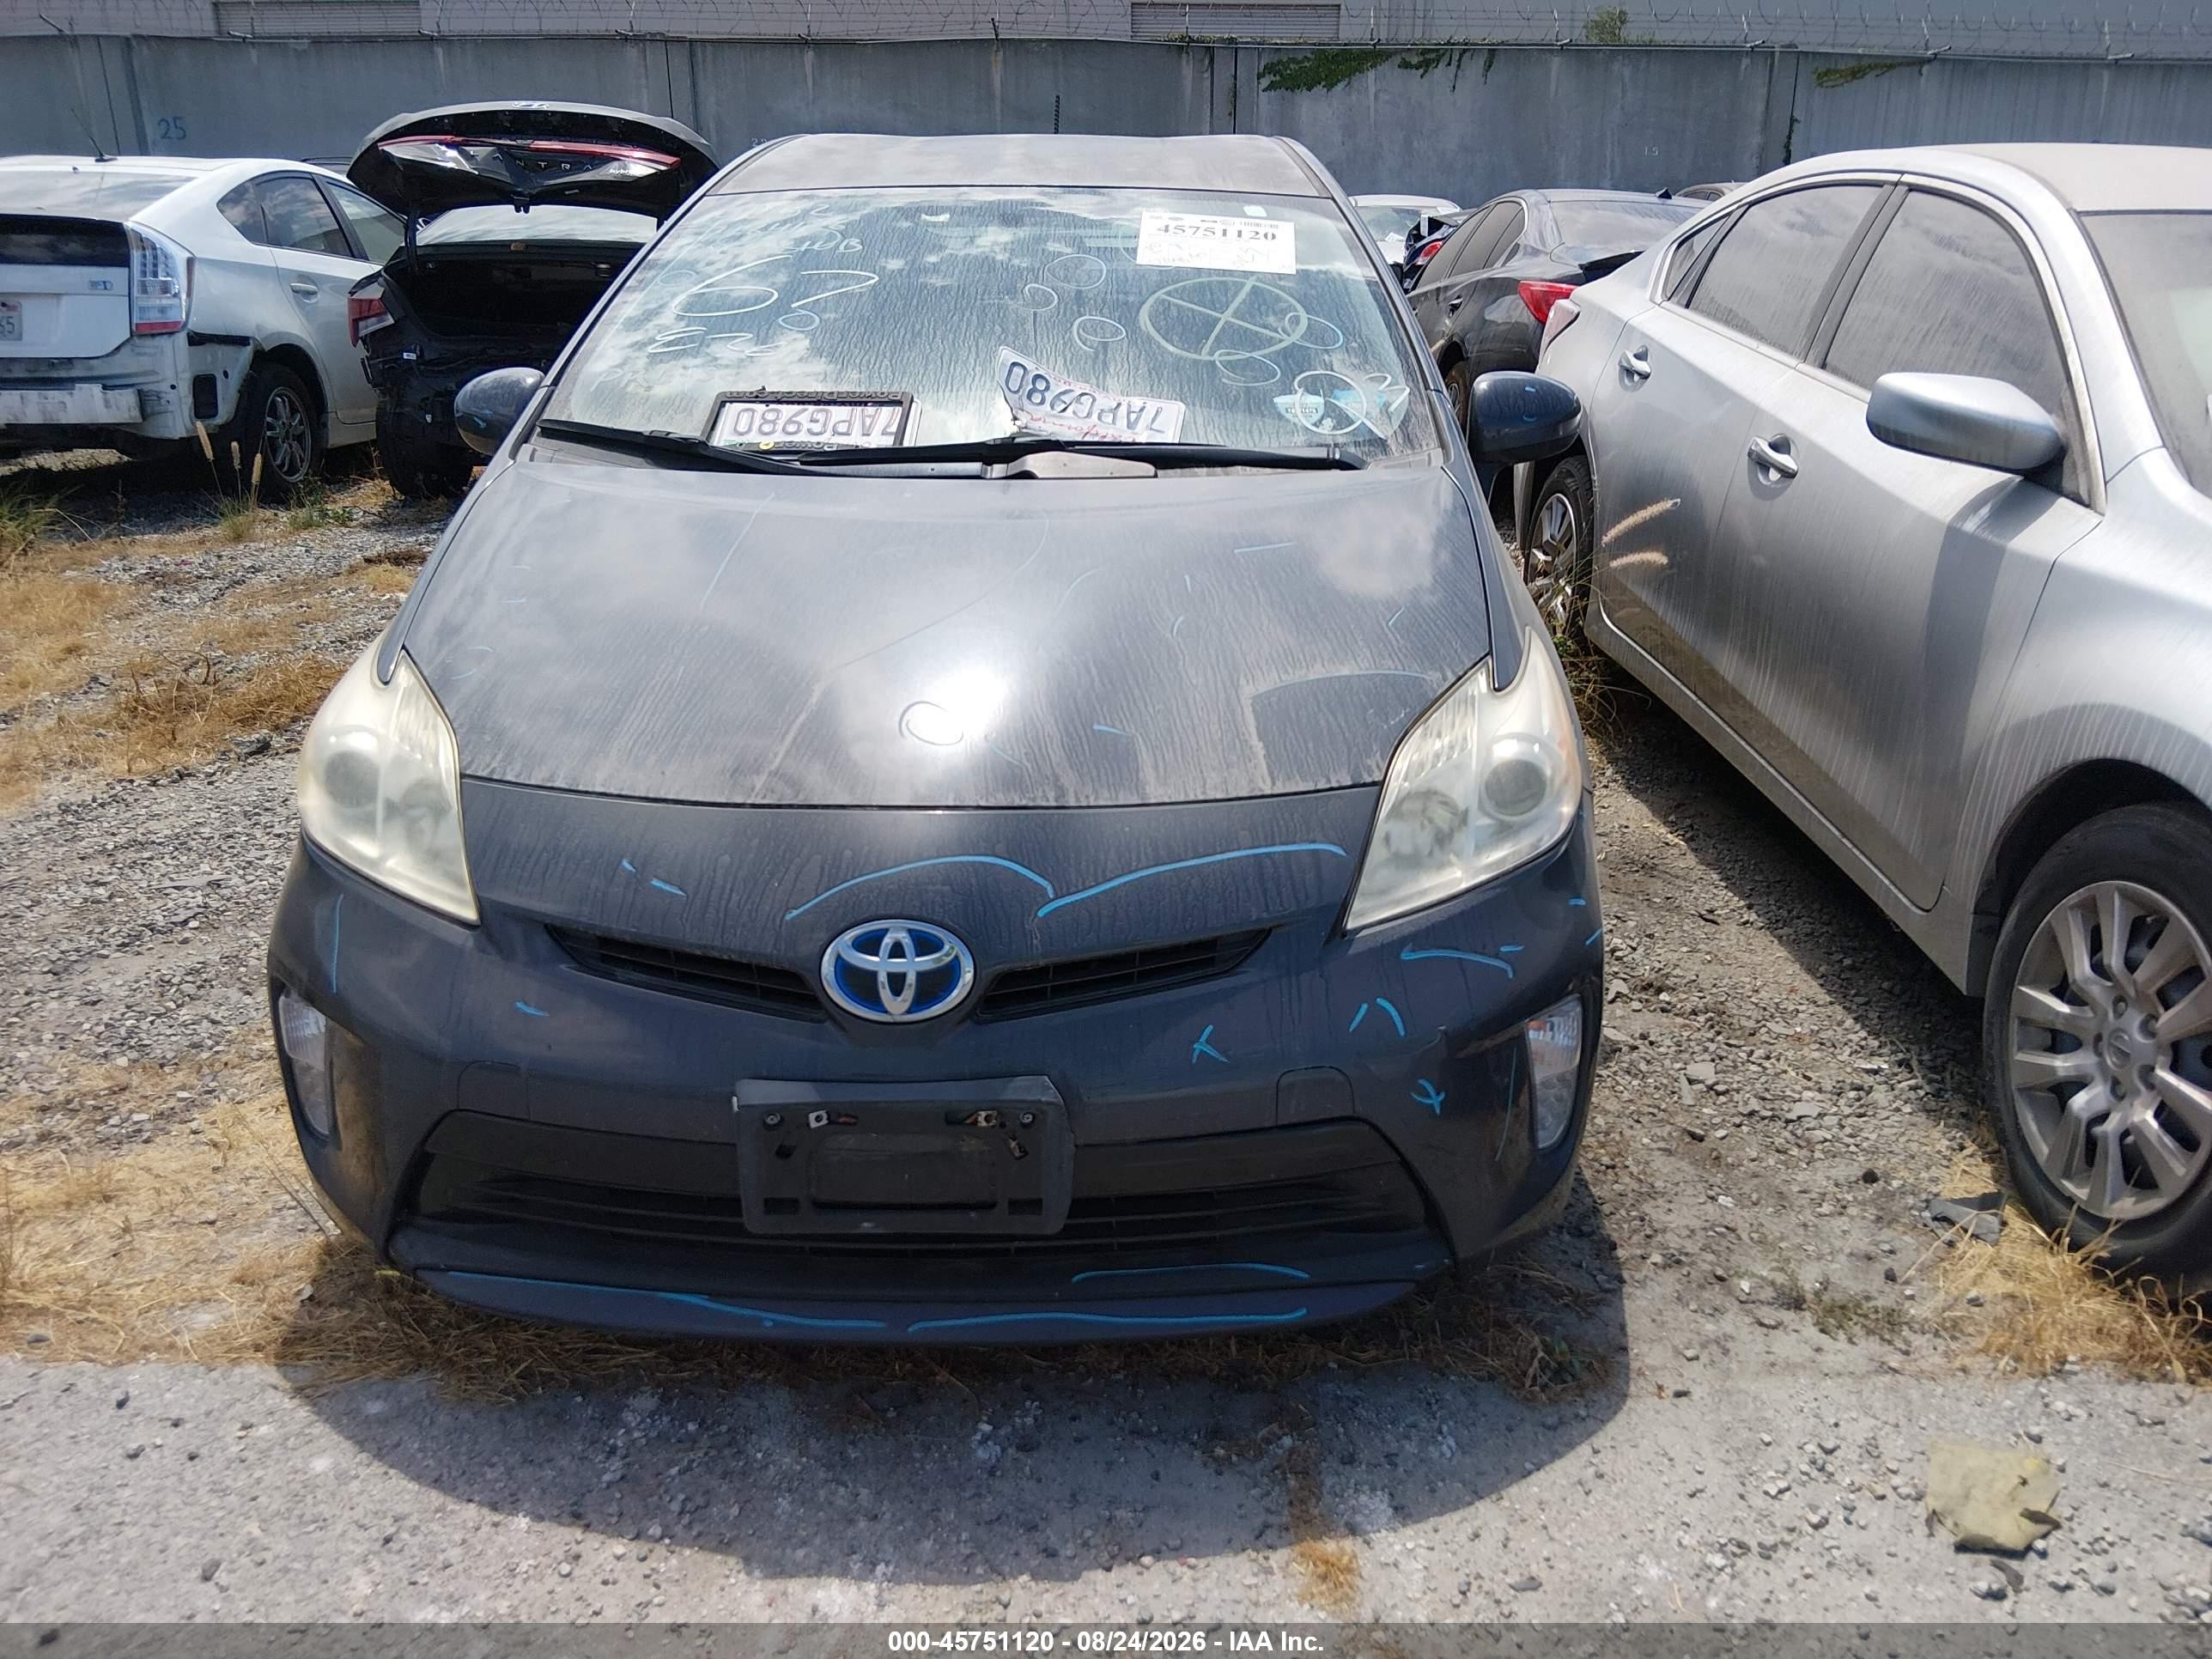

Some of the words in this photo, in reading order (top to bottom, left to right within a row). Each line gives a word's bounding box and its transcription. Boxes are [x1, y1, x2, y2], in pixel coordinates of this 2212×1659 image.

[156, 116, 186, 141] 25
[1157, 223, 1277, 241] 45751120
[1004, 360, 1166, 434] 7APG980
[734, 407, 902, 436] 7APG980
